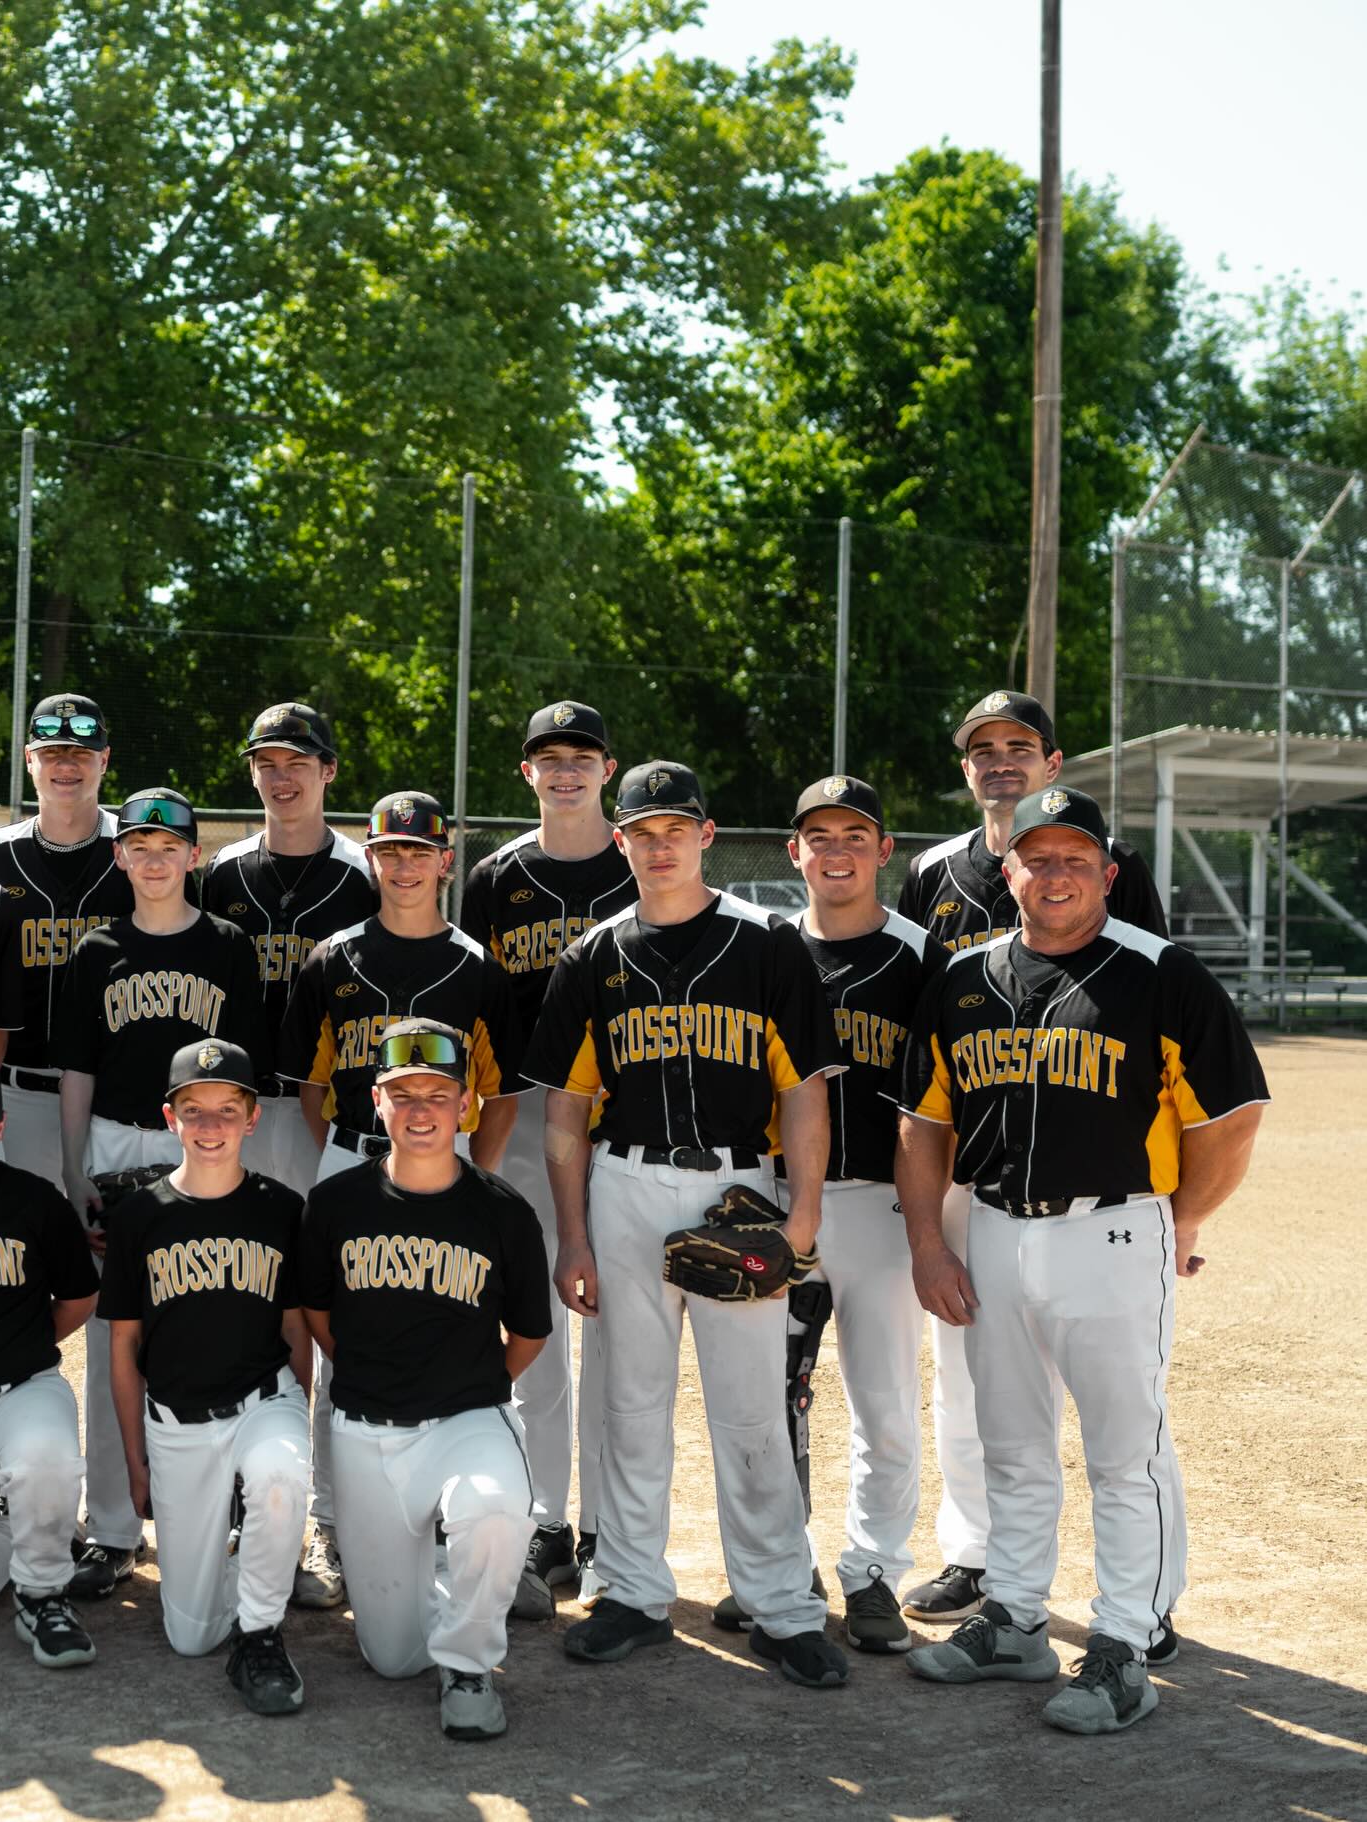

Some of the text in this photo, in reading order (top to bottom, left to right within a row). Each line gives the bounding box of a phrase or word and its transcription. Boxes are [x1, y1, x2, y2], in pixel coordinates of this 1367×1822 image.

[104, 970, 226, 1036] CROSSPOINT
[951, 1027, 1126, 1098] CROSSPOINT
[146, 1237, 284, 1307] CROSSPOINT
[341, 1235, 492, 1308] CROSSPOINT
